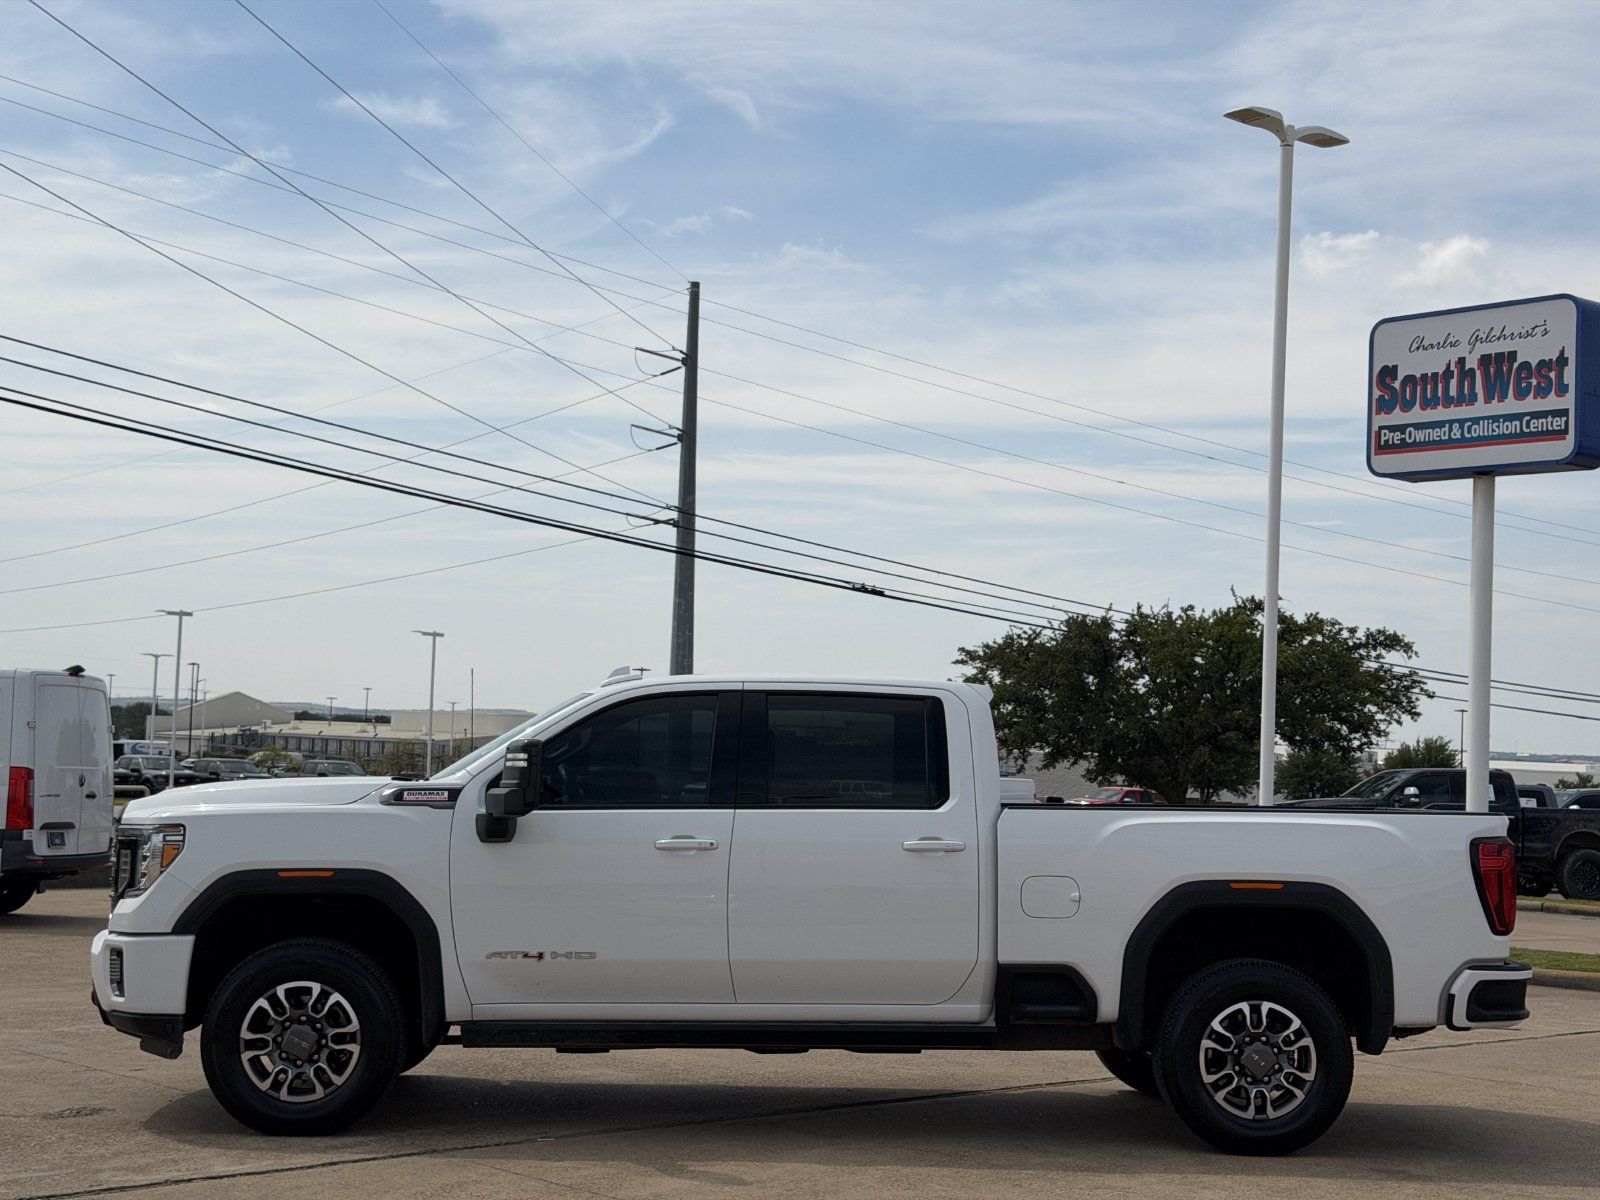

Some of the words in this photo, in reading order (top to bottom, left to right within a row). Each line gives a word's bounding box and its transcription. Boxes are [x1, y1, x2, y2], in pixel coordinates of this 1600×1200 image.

[1408, 332, 1461, 354] Charlie
[1468, 319, 1551, 355] Gilchrist's
[1375, 346, 1569, 416] SouthWest
[1380, 425, 1449, 446] Pre-Owned
[1450, 423, 1461, 439] &
[1463, 416, 1520, 438] Collision
[1522, 415, 1568, 433] Center
[485, 951, 545, 962] AT4
[551, 951, 597, 960] HD
